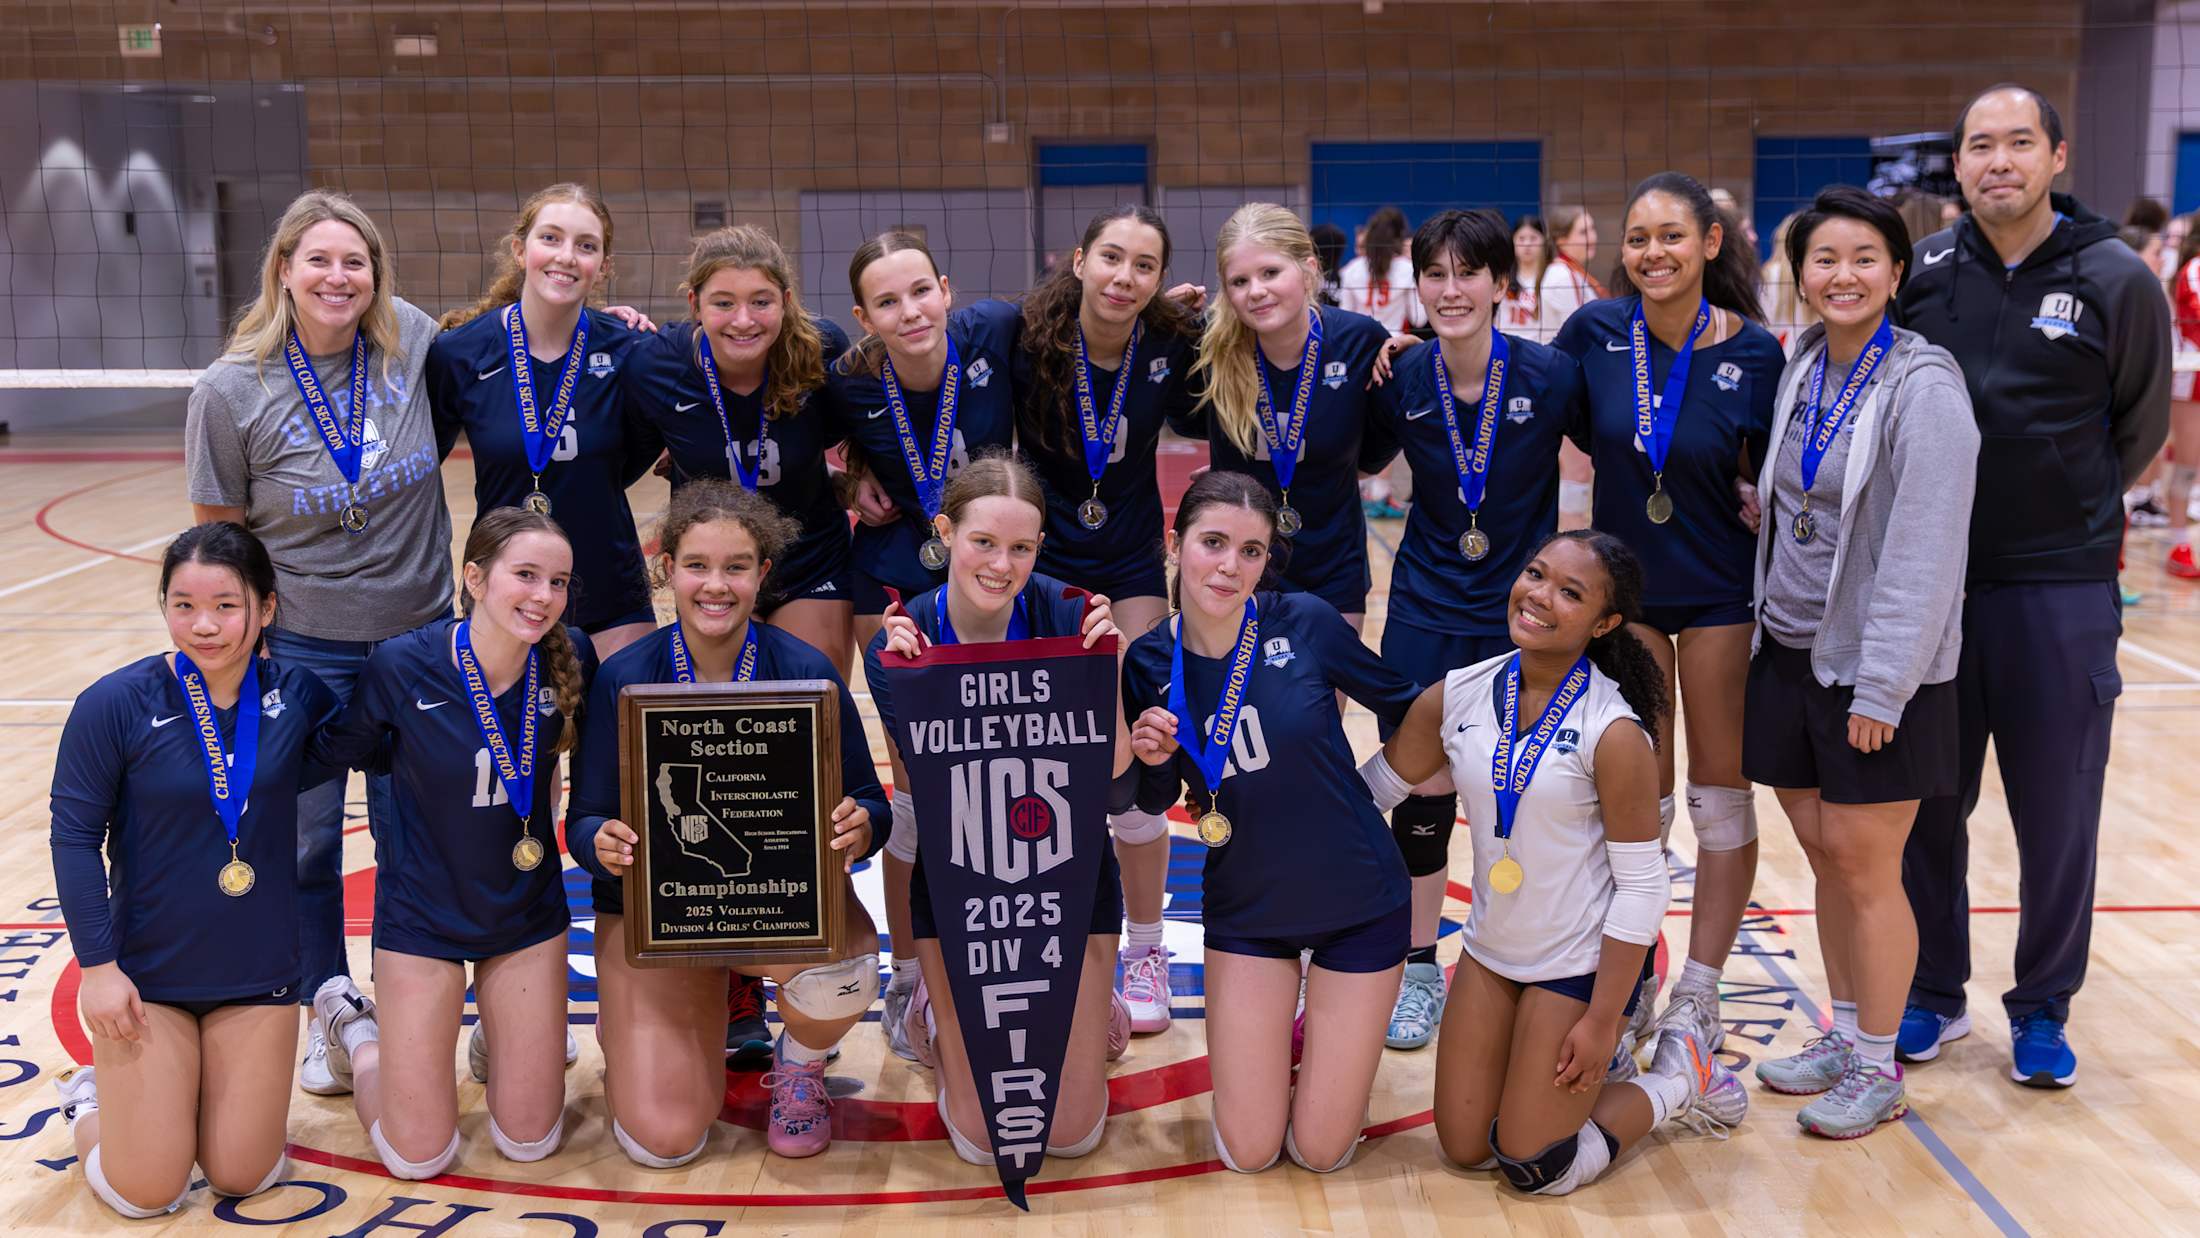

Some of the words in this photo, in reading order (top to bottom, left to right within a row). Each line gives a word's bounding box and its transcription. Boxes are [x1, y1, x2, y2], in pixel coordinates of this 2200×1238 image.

[510, 308, 525, 346] NORTH
[2055, 299, 2069, 312] U
[513, 348, 530, 384] COAST
[545, 329, 586, 438] CHAMPIONSHIPS
[1633, 320, 1652, 436] CHAMPIONSHIPS
[286, 334, 306, 368] ORTH
[298, 368, 322, 405] COAST
[313, 404, 346, 451] SECTION
[518, 385, 540, 433] SECTION
[1287, 339, 1320, 450] CHAMPIONSHIPS
[1434, 353, 1449, 392] NORTH
[1442, 392, 1456, 427] COAST
[1450, 428, 1469, 475] SECTION
[1815, 344, 1882, 452] CHAMPIONSHIPS
[881, 359, 899, 398] NORTH
[892, 400, 910, 435] COAST
[902, 436, 928, 482] SECTION
[930, 364, 959, 481] CHAMPIONSHIPS
[1079, 395, 1099, 441] SECTION
[1473, 359, 1504, 473] CHAMPIONSHIPS
[672, 630, 688, 672] NORTH
[1272, 641, 1280, 650] U
[960, 669, 1050, 707] GIRLS
[1214, 618, 1258, 746] CHAMPIONSHIPS
[1555, 668, 1588, 712] NORTH
[183, 672, 229, 800] CHAMPIONSHIPS
[460, 649, 484, 692] NORTH
[474, 693, 498, 731] COAST
[488, 731, 518, 780] SECTION
[661, 720, 725, 736] North
[736, 717, 796, 734] Coast
[909, 710, 1108, 754] VOLLEYBALL
[1494, 670, 1518, 791] CHAMPIONSHIPS
[1540, 706, 1564, 744] COAST
[690, 740, 768, 757] Section
[1513, 743, 1542, 794] SECTION
[706, 772, 766, 783] CALIFORNIA
[710, 790, 799, 801] INTERSCHOLASTIC
[680, 815, 708, 844] NCS
[722, 808, 783, 819] FEDERATION
[950, 758, 1074, 884] NCS
[1014, 802, 1046, 833] CIF
[659, 879, 808, 899] Championships
[686, 906, 713, 917] 2025
[718, 905, 784, 916] VOLLEYBALL
[661, 923, 704, 934] DIVISION
[707, 922, 714, 932] 4
[752, 920, 810, 931] CHAMPIONS
[964, 891, 1062, 932] 2025
[967, 938, 1022, 976] DIV
[1040, 935, 1062, 968] 4
[981, 979, 1050, 1169] FIRST
